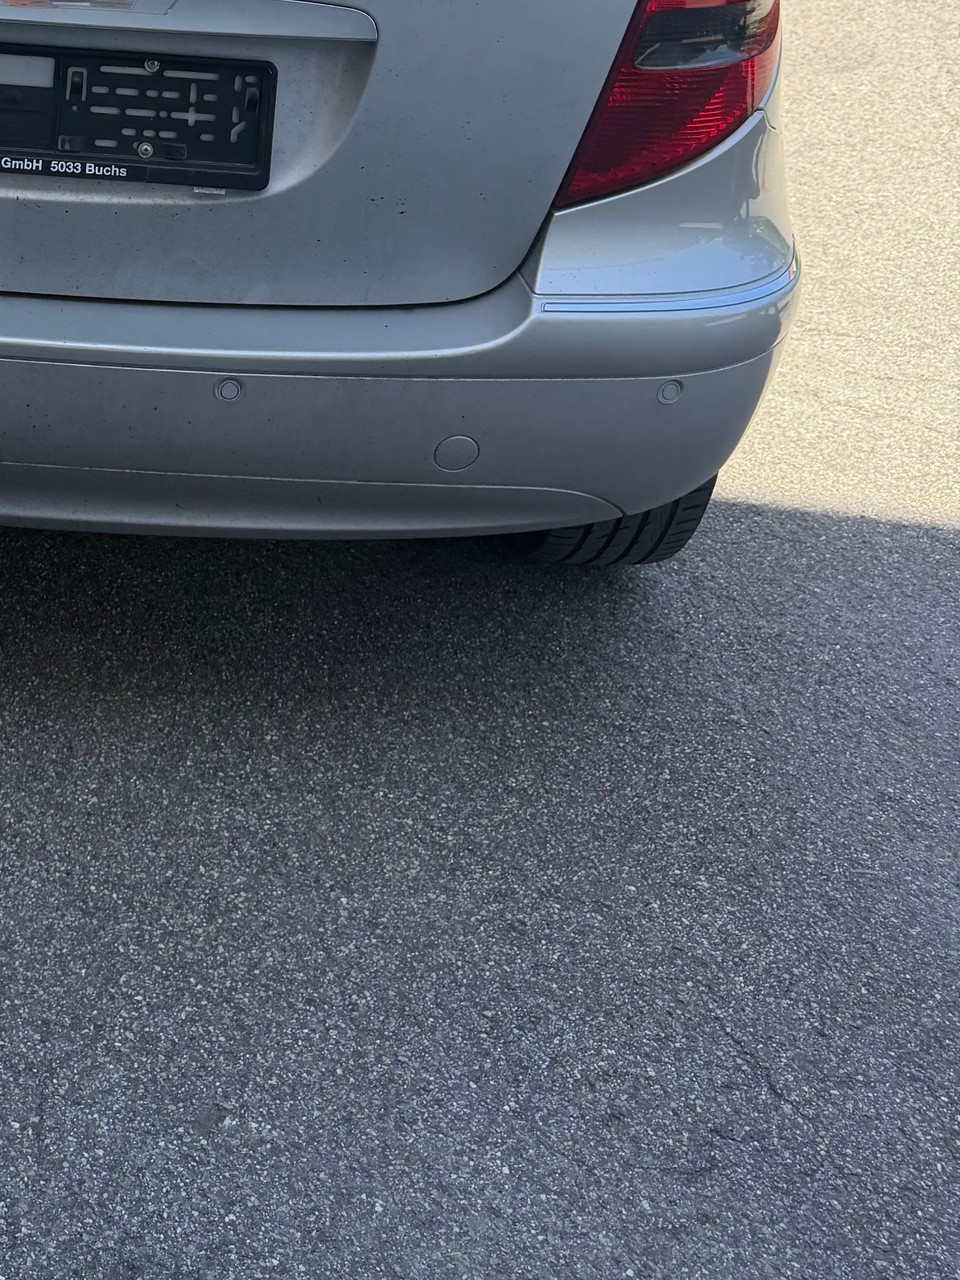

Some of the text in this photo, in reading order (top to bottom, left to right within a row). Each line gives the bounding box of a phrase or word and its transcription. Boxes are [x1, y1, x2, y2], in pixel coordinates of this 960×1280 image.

[1, 157, 43, 171] GmbH
[50, 161, 81, 173] 5033
[85, 164, 127, 177] Buchs
